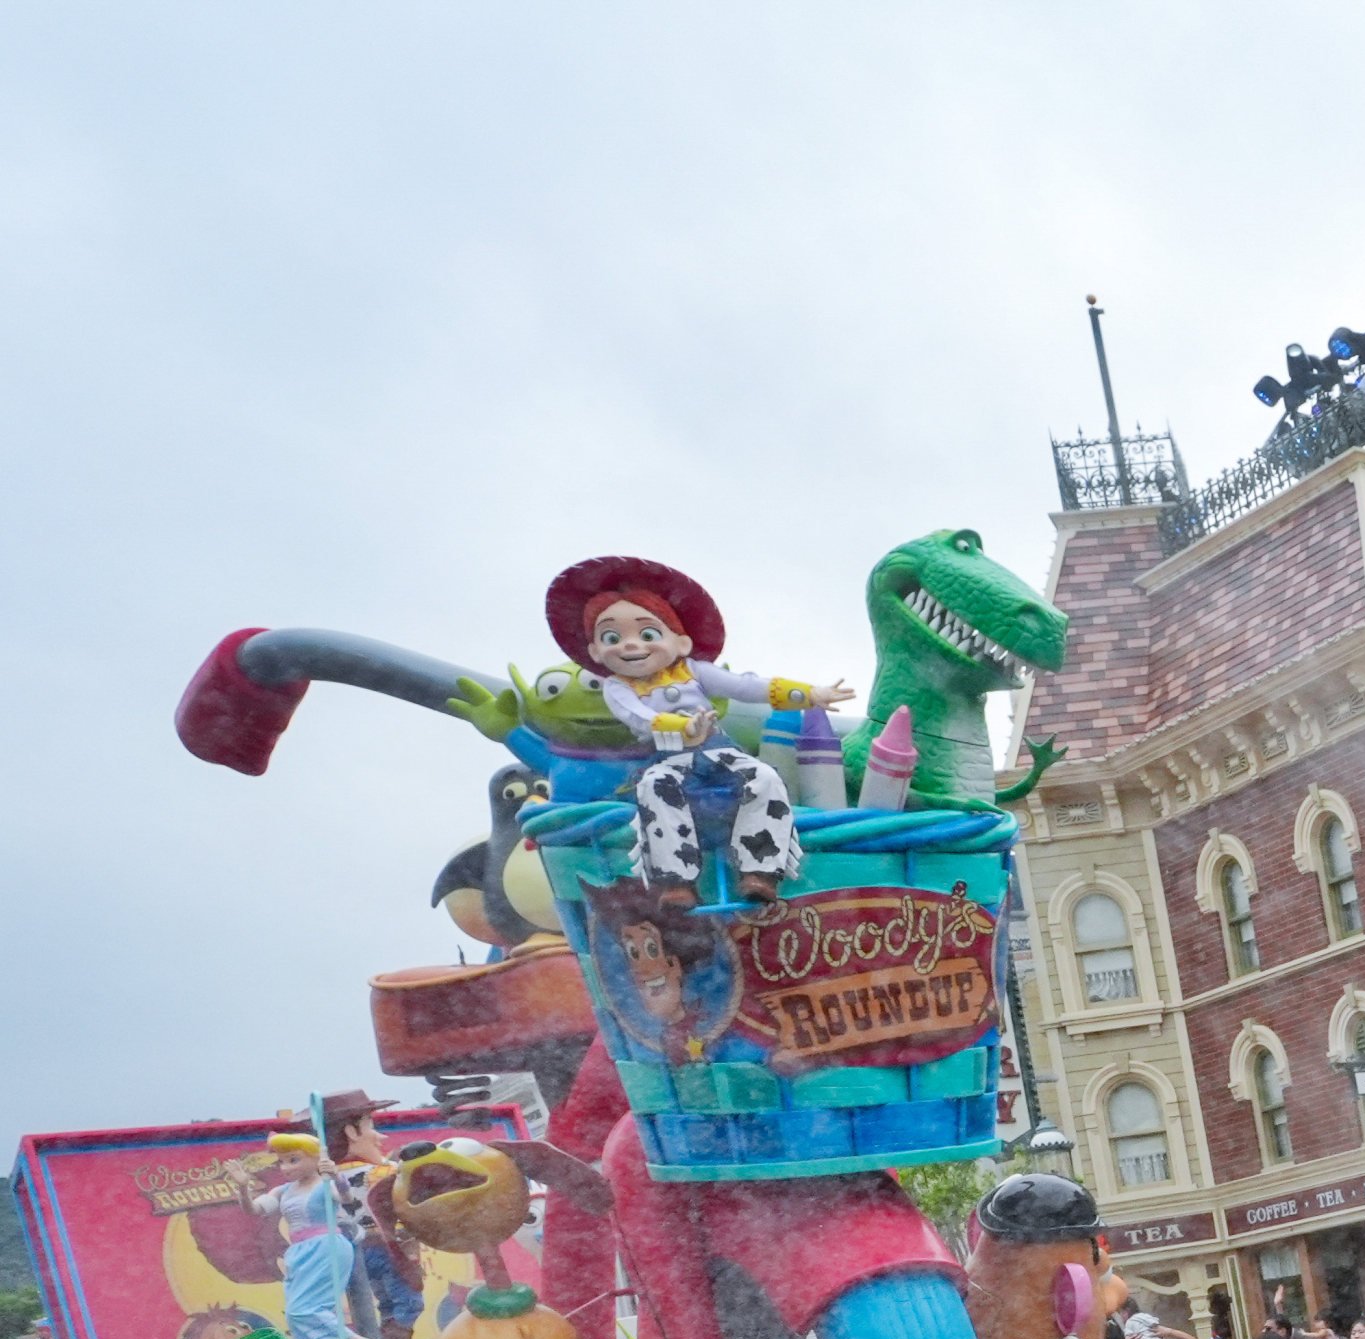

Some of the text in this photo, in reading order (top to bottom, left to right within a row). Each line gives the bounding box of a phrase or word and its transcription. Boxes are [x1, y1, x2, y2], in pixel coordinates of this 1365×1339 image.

[745, 889, 994, 982] Woody's
[780, 971, 974, 1049] ROUNDUP
[1124, 1223, 1185, 1245] TEA
[1245, 1199, 1298, 1226] COFFEE
[1315, 1188, 1345, 1209] TEA
